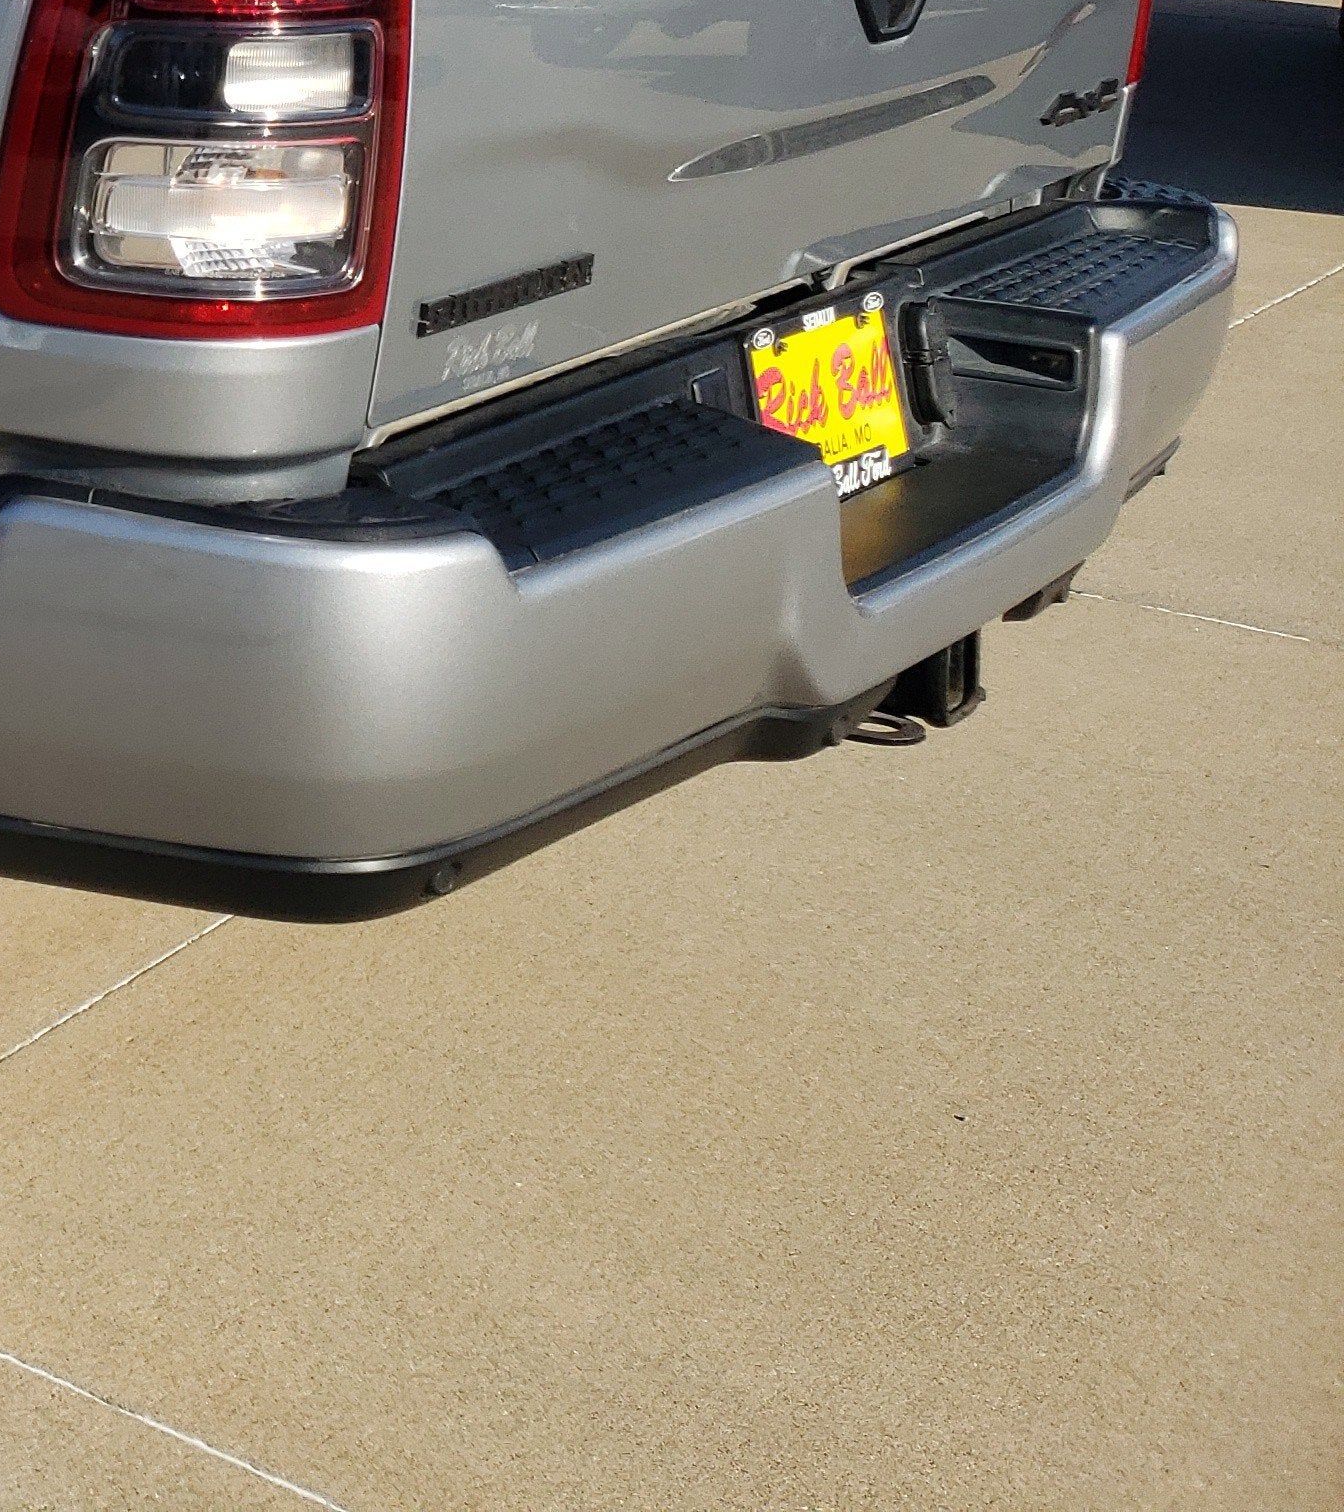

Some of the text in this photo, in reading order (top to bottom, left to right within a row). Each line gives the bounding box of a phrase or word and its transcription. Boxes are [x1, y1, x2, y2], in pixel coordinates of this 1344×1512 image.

[755, 335, 893, 437] Rick Ball
[822, 435, 852, 456] ALIA,
[861, 449, 893, 486] Ford
